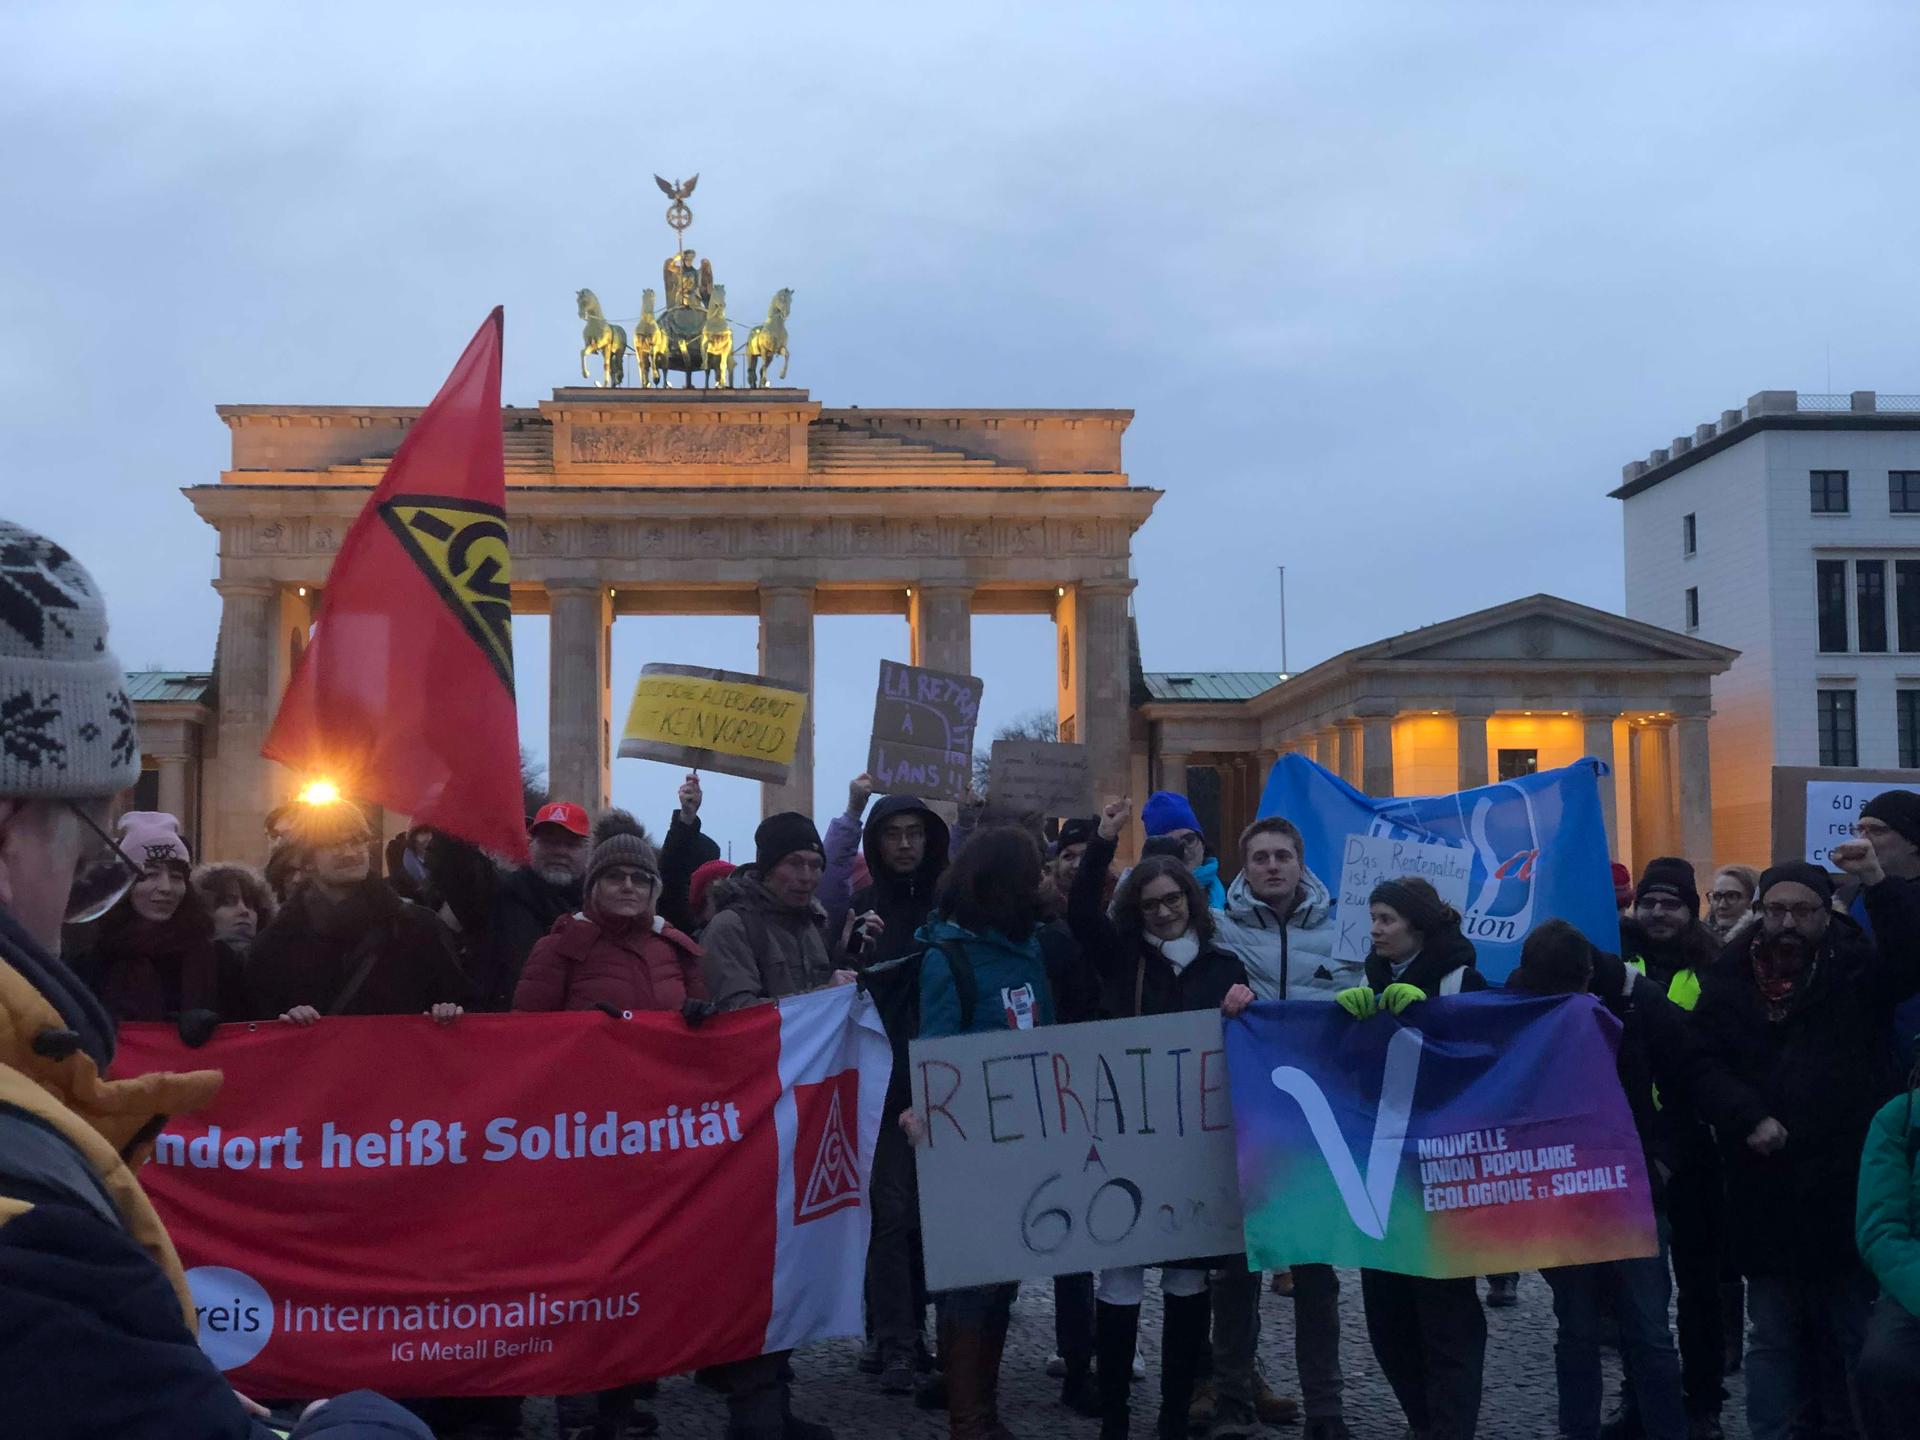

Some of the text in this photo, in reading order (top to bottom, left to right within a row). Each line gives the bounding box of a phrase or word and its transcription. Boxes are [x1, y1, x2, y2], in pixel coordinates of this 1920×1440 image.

[883, 666, 910, 698] LA
[1831, 795, 1853, 810] 60
[1828, 822, 1854, 836] ret
[1345, 838, 1468, 880] Das Rentenalter
[1813, 847, 1833, 861] c'e
[1338, 919, 1372, 954] Ko
[1465, 909, 1516, 939] ion
[917, 1048, 1231, 1148] RETRAITE
[153, 1100, 744, 1170] ndort heißt Solidarität
[1418, 1128, 1508, 1160] NOUVELLE
[1420, 1144, 1577, 1185] UNION POPULAIRE
[1422, 1178, 1535, 1213] ÉCOLOGIQUE
[1551, 1165, 1628, 1197] SOCIALE
[1020, 1170, 1144, 1255] 60
[194, 1290, 641, 1333] reis Internationalismus
[391, 1335, 553, 1362] IG Metall Berlin
